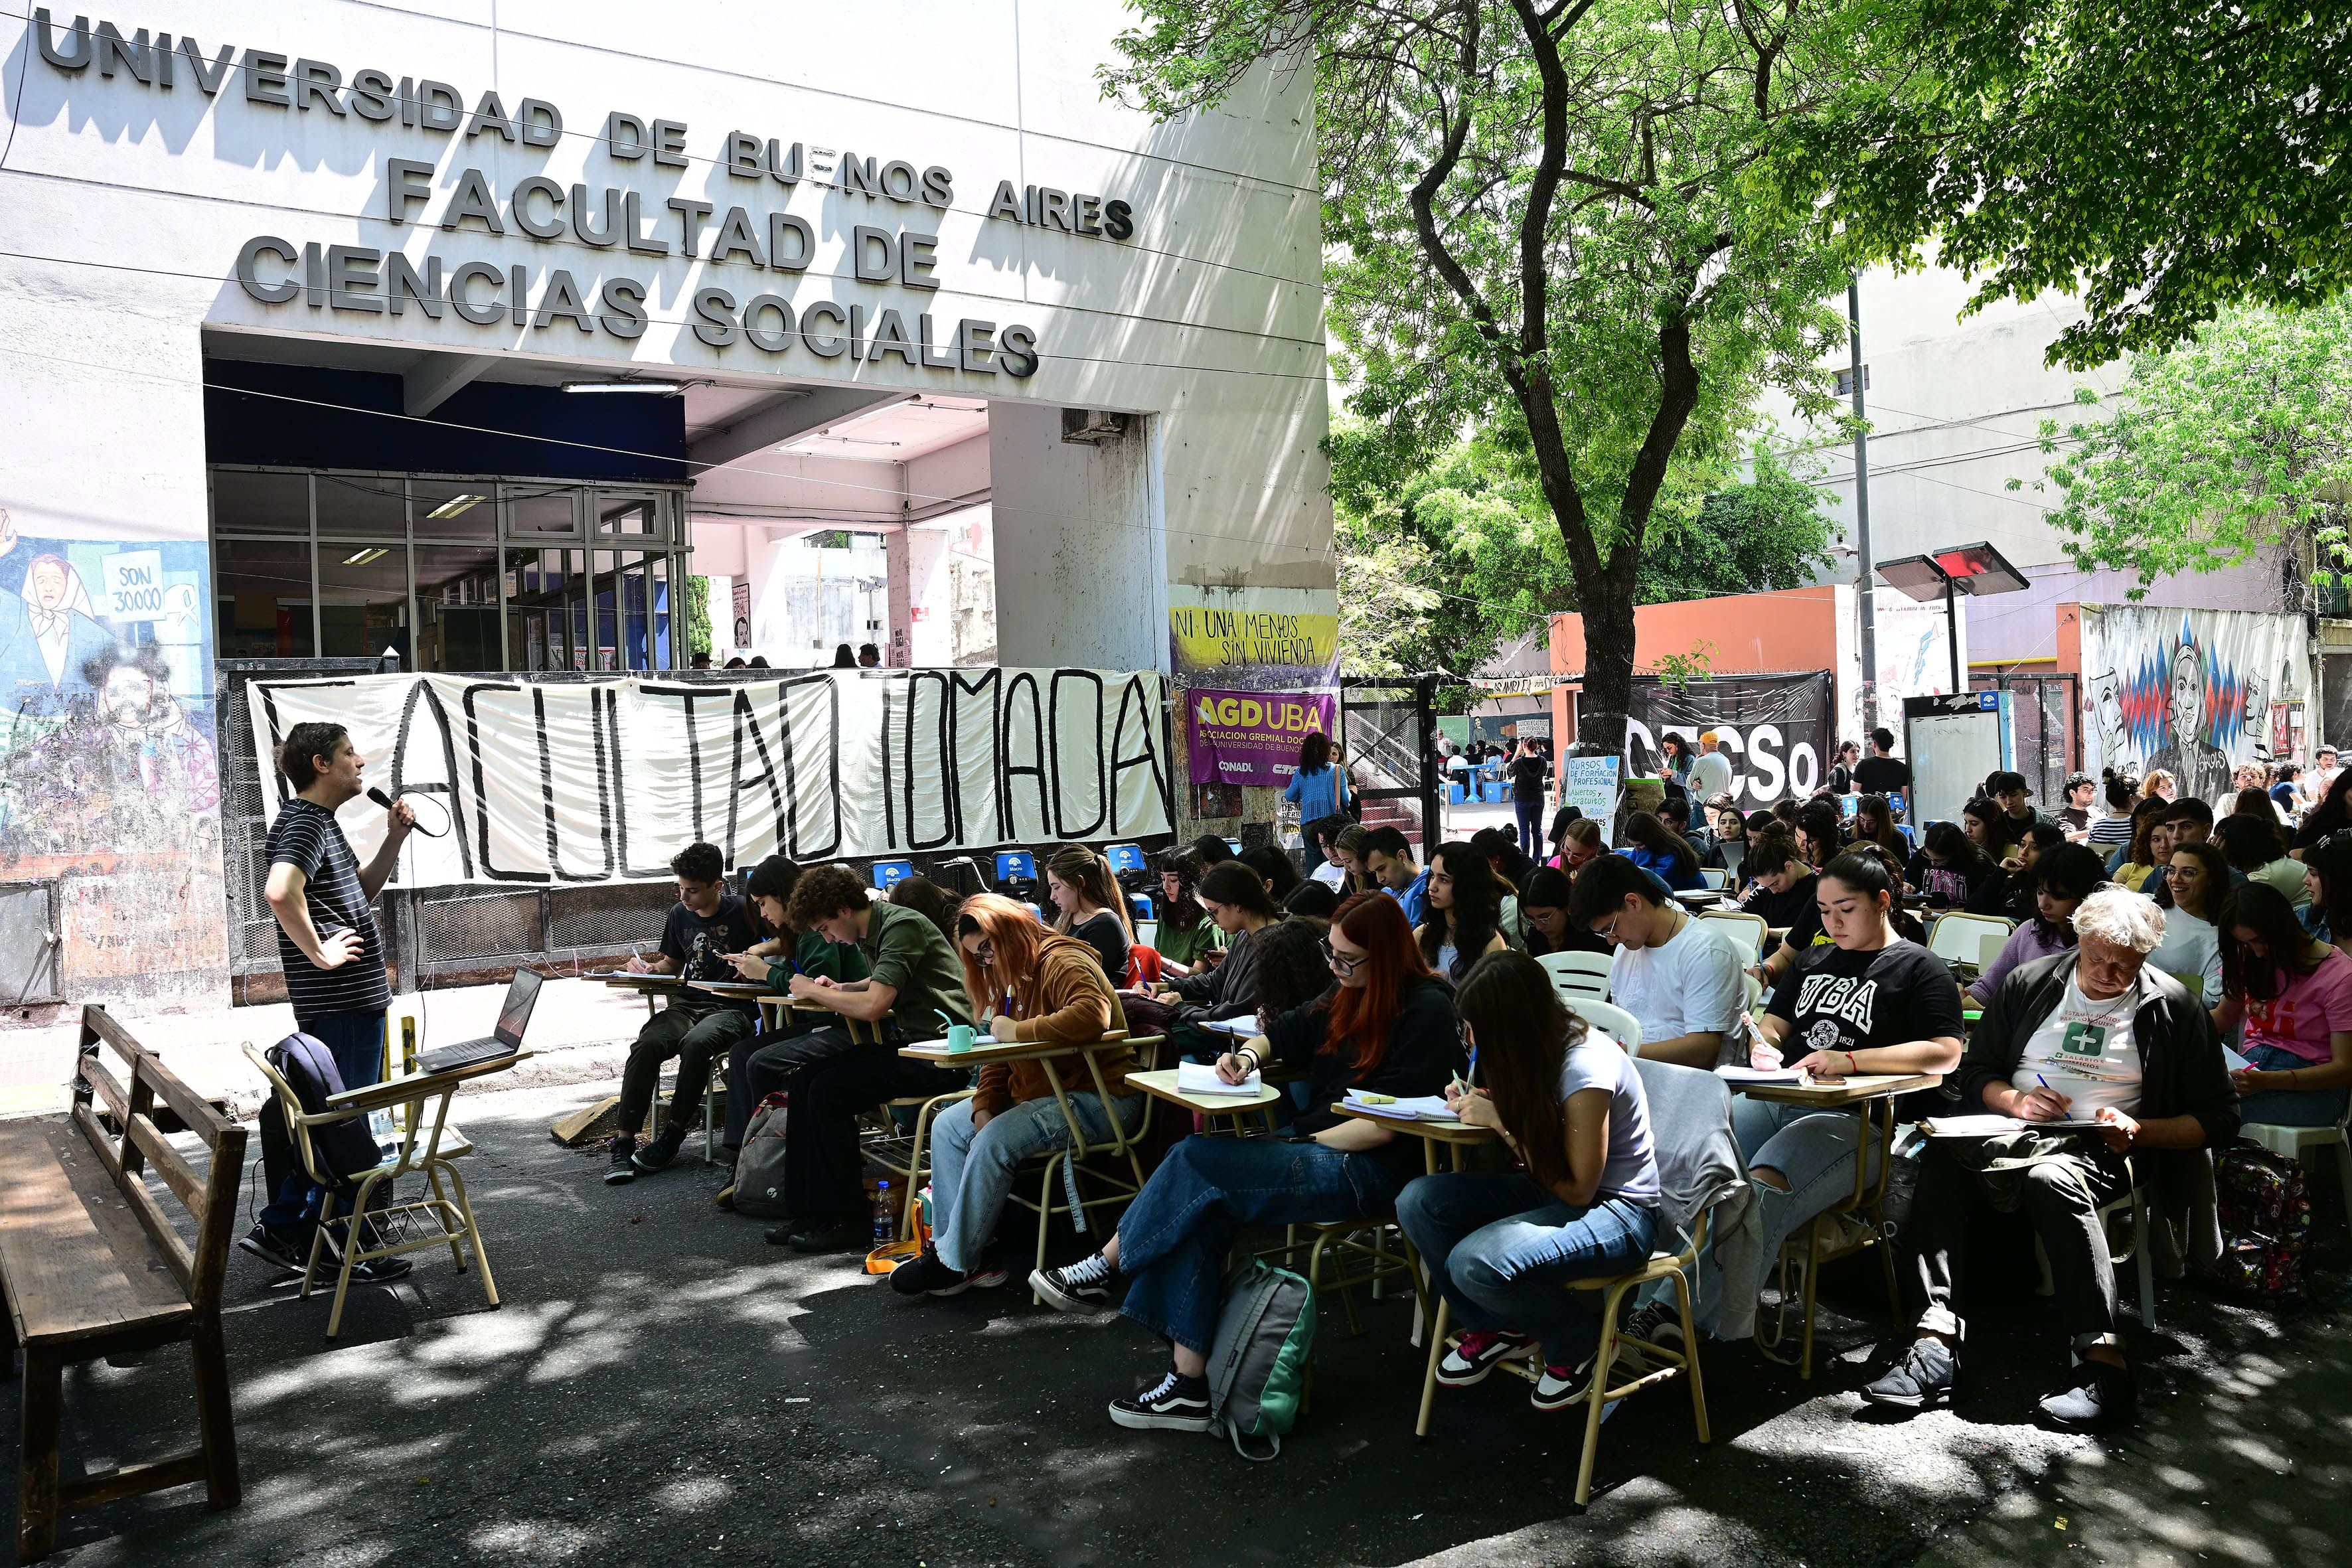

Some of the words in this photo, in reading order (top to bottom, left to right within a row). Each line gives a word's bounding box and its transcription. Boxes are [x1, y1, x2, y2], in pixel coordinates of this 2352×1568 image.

[35, 7, 564, 147] UNIVERSIDAD
[609, 111, 689, 167] DE
[729, 131, 953, 207] BUENOS
[989, 180, 1133, 240] AIRES
[389, 158, 815, 269] FACULTAD
[854, 225, 939, 289] DE
[237, 236, 649, 338] CIENCIAS
[694, 287, 1039, 377] SOCIALES
[119, 566, 152, 586] SON
[1176, 610, 1193, 638] NI
[1204, 610, 1237, 639] UNA
[1245, 613, 1298, 639] MENOS
[1221, 640, 1247, 665] SIN
[1254, 636, 1316, 665] VIVIENDA
[1198, 696, 1263, 727] AGD
[1266, 701, 1323, 734] UBA
[1200, 730, 1246, 740] ASOCIACION
[1249, 732, 1285, 743] GREMIAL
[1287, 736, 1307, 744] DOC
[1215, 740, 1263, 749] UNIVERSIDAD
[1276, 744, 1302, 754] BUENOS
[257, 673, 840, 884] FACULTAD
[860, 668, 1172, 851] TOMADA
[1571, 760, 1601, 769] CURSOS
[1573, 777, 1615, 786] PROFESIONAL
[1572, 797, 1607, 807] Gratuitos
[1794, 973, 1877, 1036] UBA
[1838, 1035, 1855, 1046] 1821
